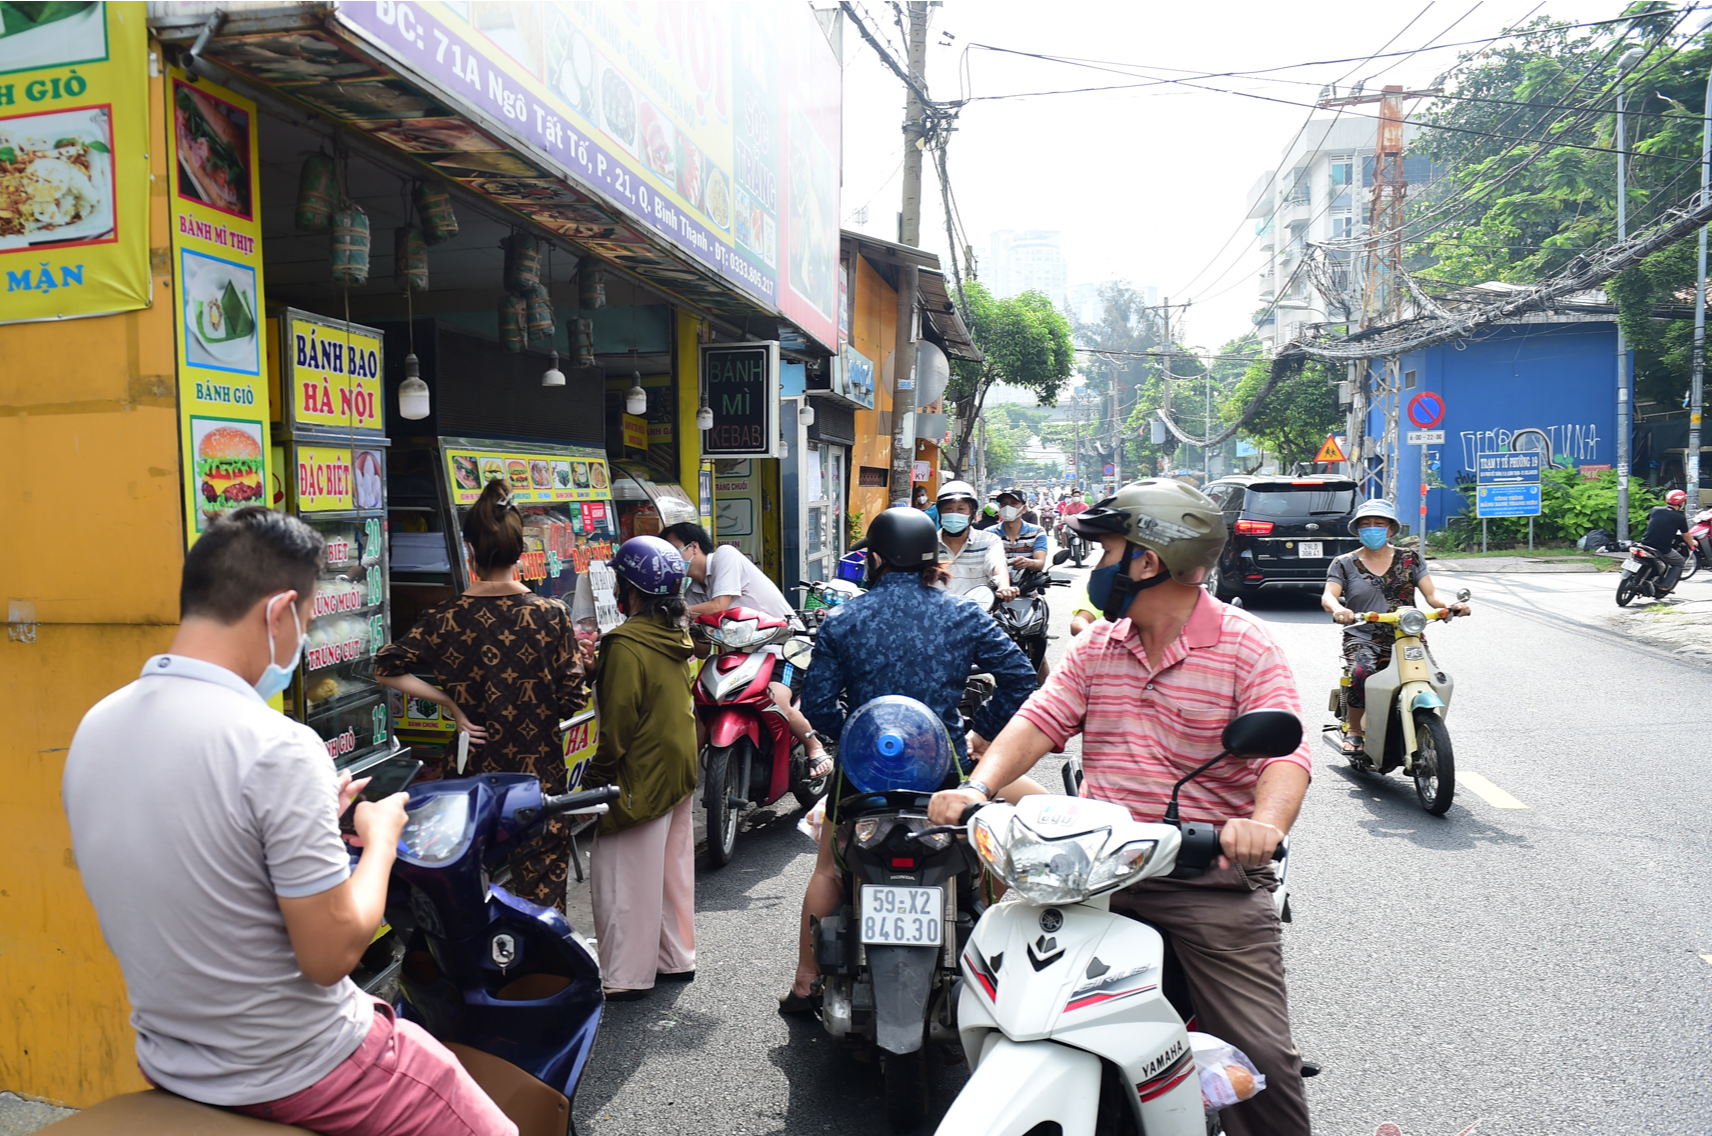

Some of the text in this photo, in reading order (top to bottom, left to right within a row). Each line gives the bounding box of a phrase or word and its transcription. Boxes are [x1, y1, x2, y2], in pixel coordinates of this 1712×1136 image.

[25, 69, 87, 102] GIÒ
[744, 91, 769, 155] SÓC
[433, 28, 481, 91] 71A
[488, 69, 527, 122] Ngô
[533, 104, 564, 150] Tất
[567, 129, 592, 174] Tố,
[597, 153, 611, 184] P.
[615, 167, 636, 205] 21,
[639, 186, 652, 213] Q.
[654, 196, 678, 233] Bình
[680, 214, 708, 252] Thạnh
[715, 242, 729, 269] ĐT:
[729, 251, 774, 297] 0333.805.217
[736, 137, 776, 215] TRĂNG
[179, 213, 255, 256] BÁNH MÌ THỊT
[6, 261, 85, 294] MẶN
[296, 328, 377, 380] BÁNH BAO
[710, 356, 763, 383] BÁNH
[195, 379, 254, 405] BÁNH GIÒ
[303, 376, 375, 424] HÀ NỘI
[722, 392, 750, 415] MÌ
[711, 425, 762, 447] KEBAB
[299, 453, 350, 503] ĐẶC BIỆT
[327, 536, 349, 567] BIỆT
[364, 517, 381, 559] 20
[366, 565, 382, 607] 18
[519, 551, 547, 585] THỊT
[337, 581, 361, 612] MUỐI
[368, 614, 384, 656] 15
[308, 641, 341, 671] TRỨNG
[339, 726, 356, 755] GIÒ
[372, 703, 387, 746] 12
[865, 916, 938, 942] 846.30
[1142, 1040, 1184, 1078] YAMAHA
